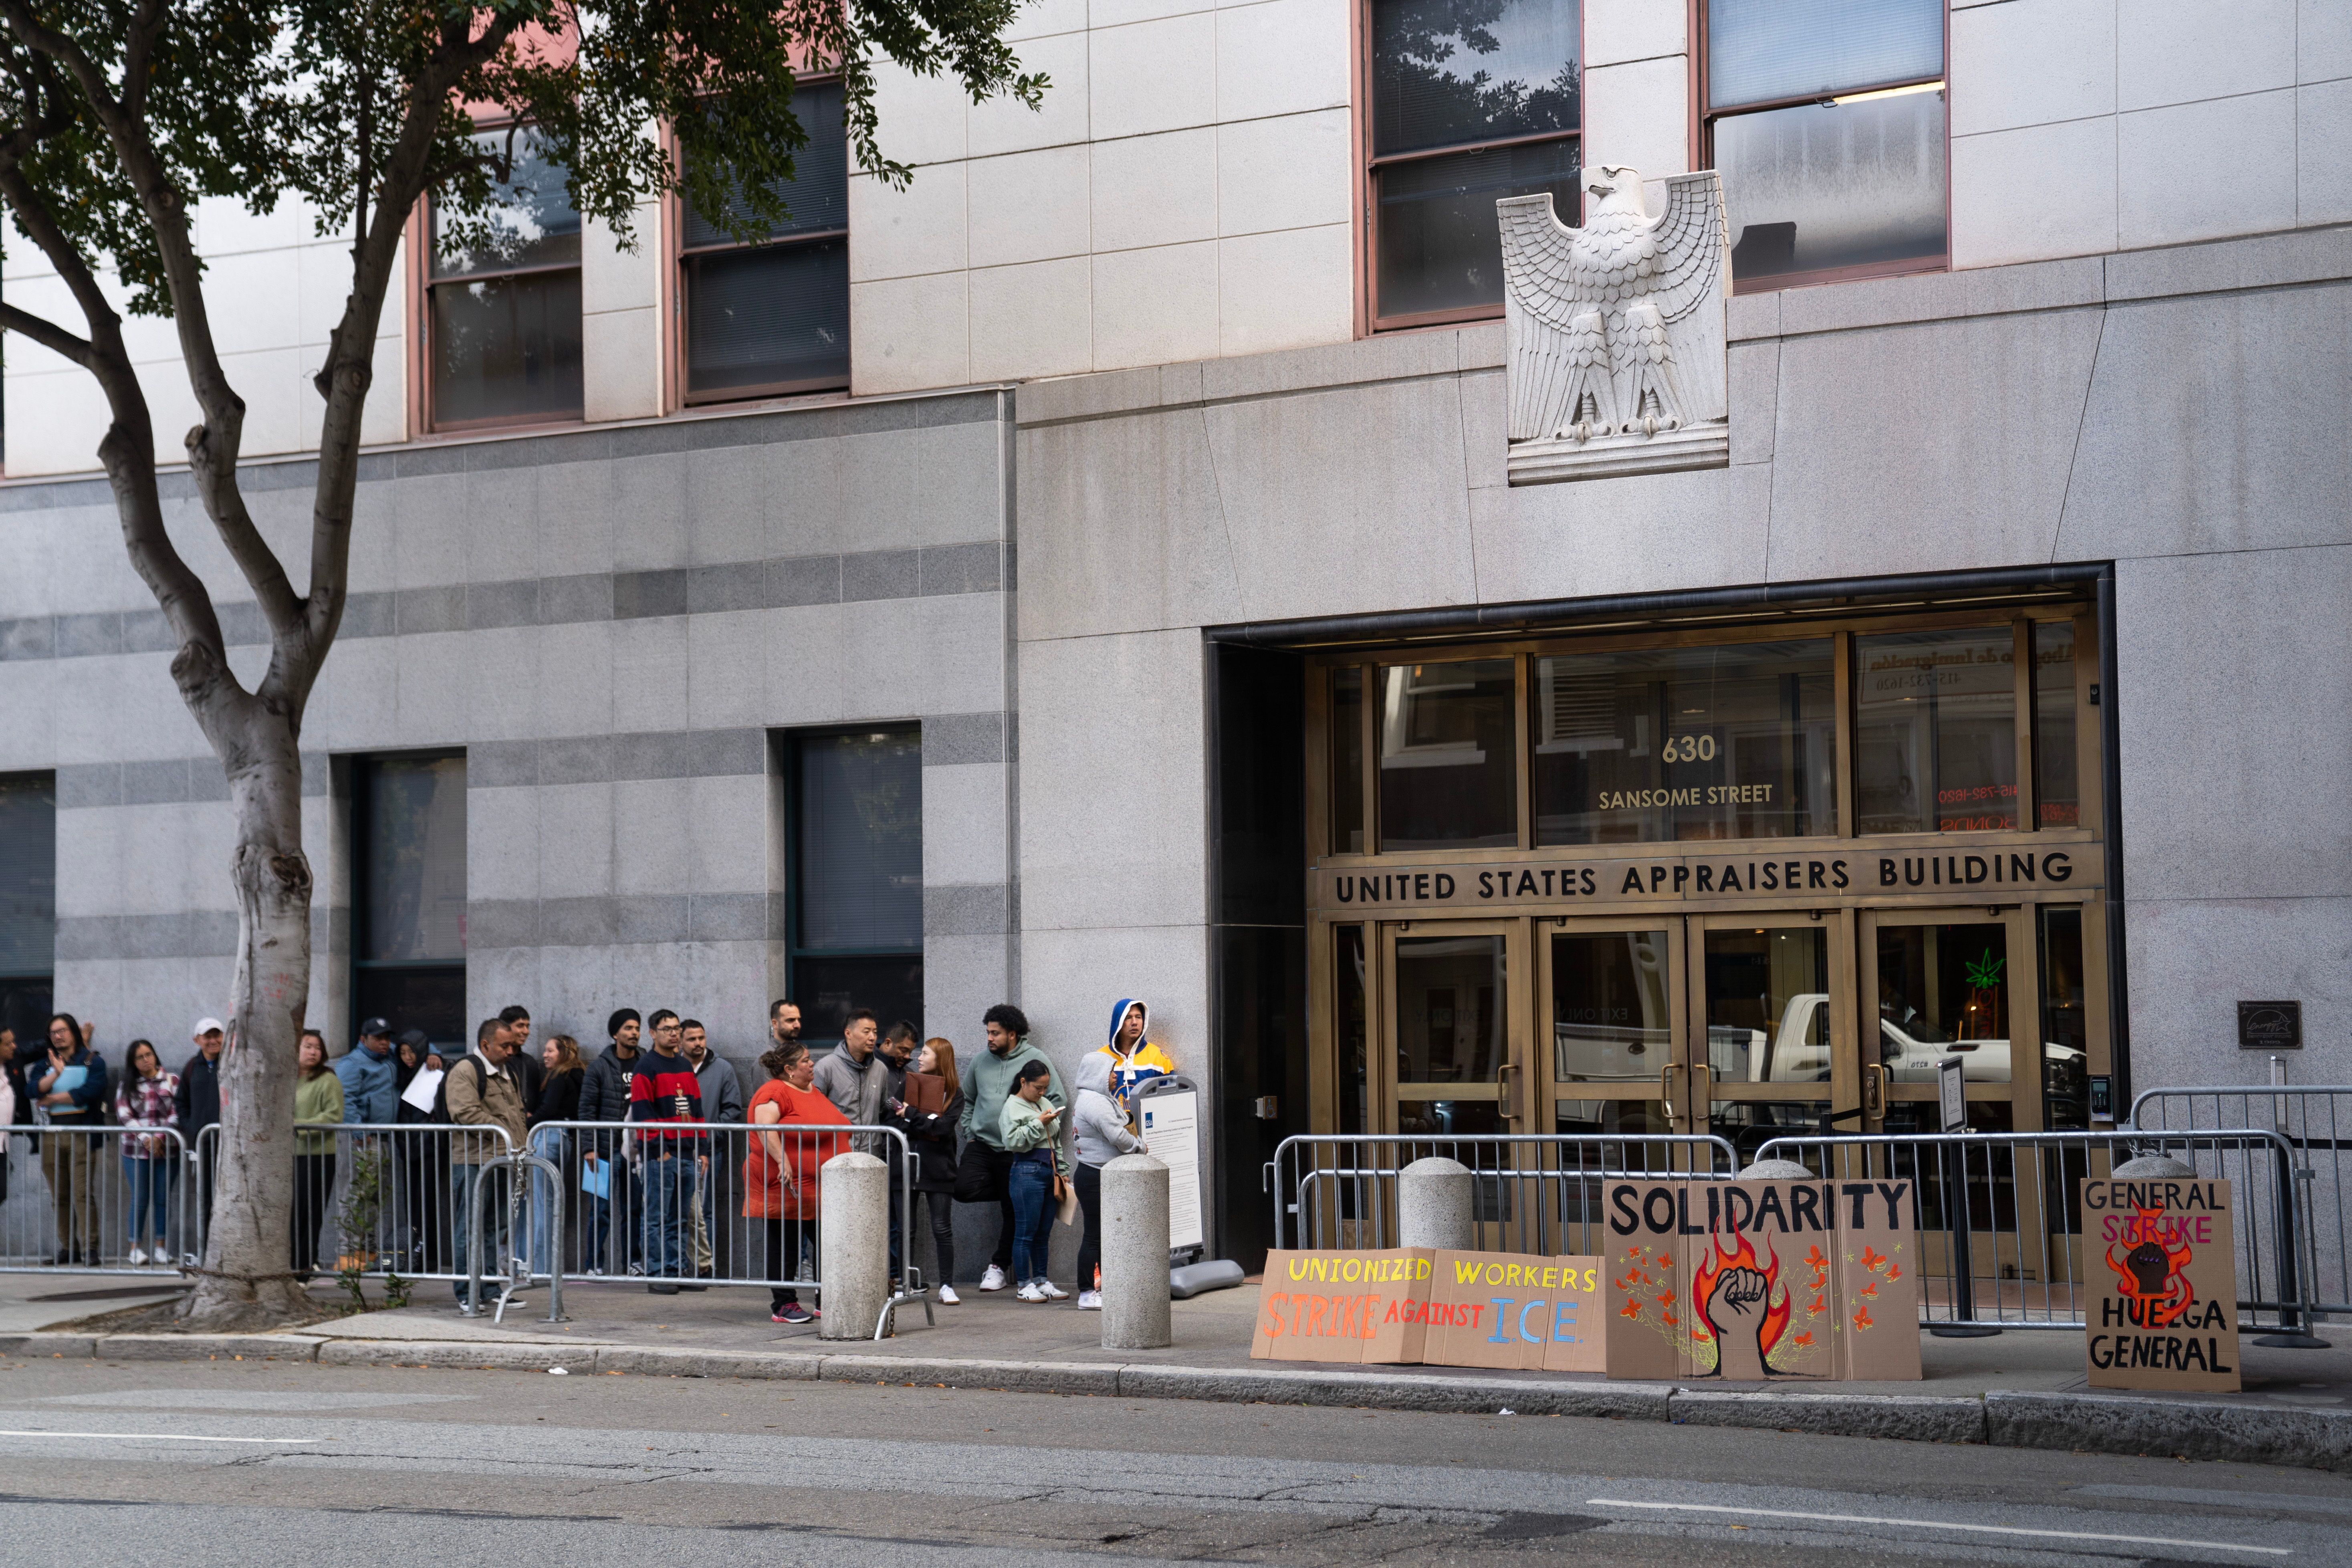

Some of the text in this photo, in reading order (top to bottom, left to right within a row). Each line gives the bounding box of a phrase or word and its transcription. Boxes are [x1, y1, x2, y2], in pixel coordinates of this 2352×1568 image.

[1662, 735, 1715, 763] 630
[1599, 784, 1772, 809] SANSOME STREET
[1336, 852, 2072, 903] UNITED STATES APPRAISERS BUILDING
[1610, 1183, 1908, 1236] SOLIDARITY
[2086, 1181, 2225, 1210] GENERAL
[2101, 1215, 2212, 1243] STRIKE
[1289, 1257, 1597, 1293] UNIONIZED WORKERS
[1263, 1292, 1584, 1343] STRIKE AGAINST I.C.E.
[2102, 1297, 2227, 1331] HUELGA
[2090, 1335, 2232, 1373] GENERAL
